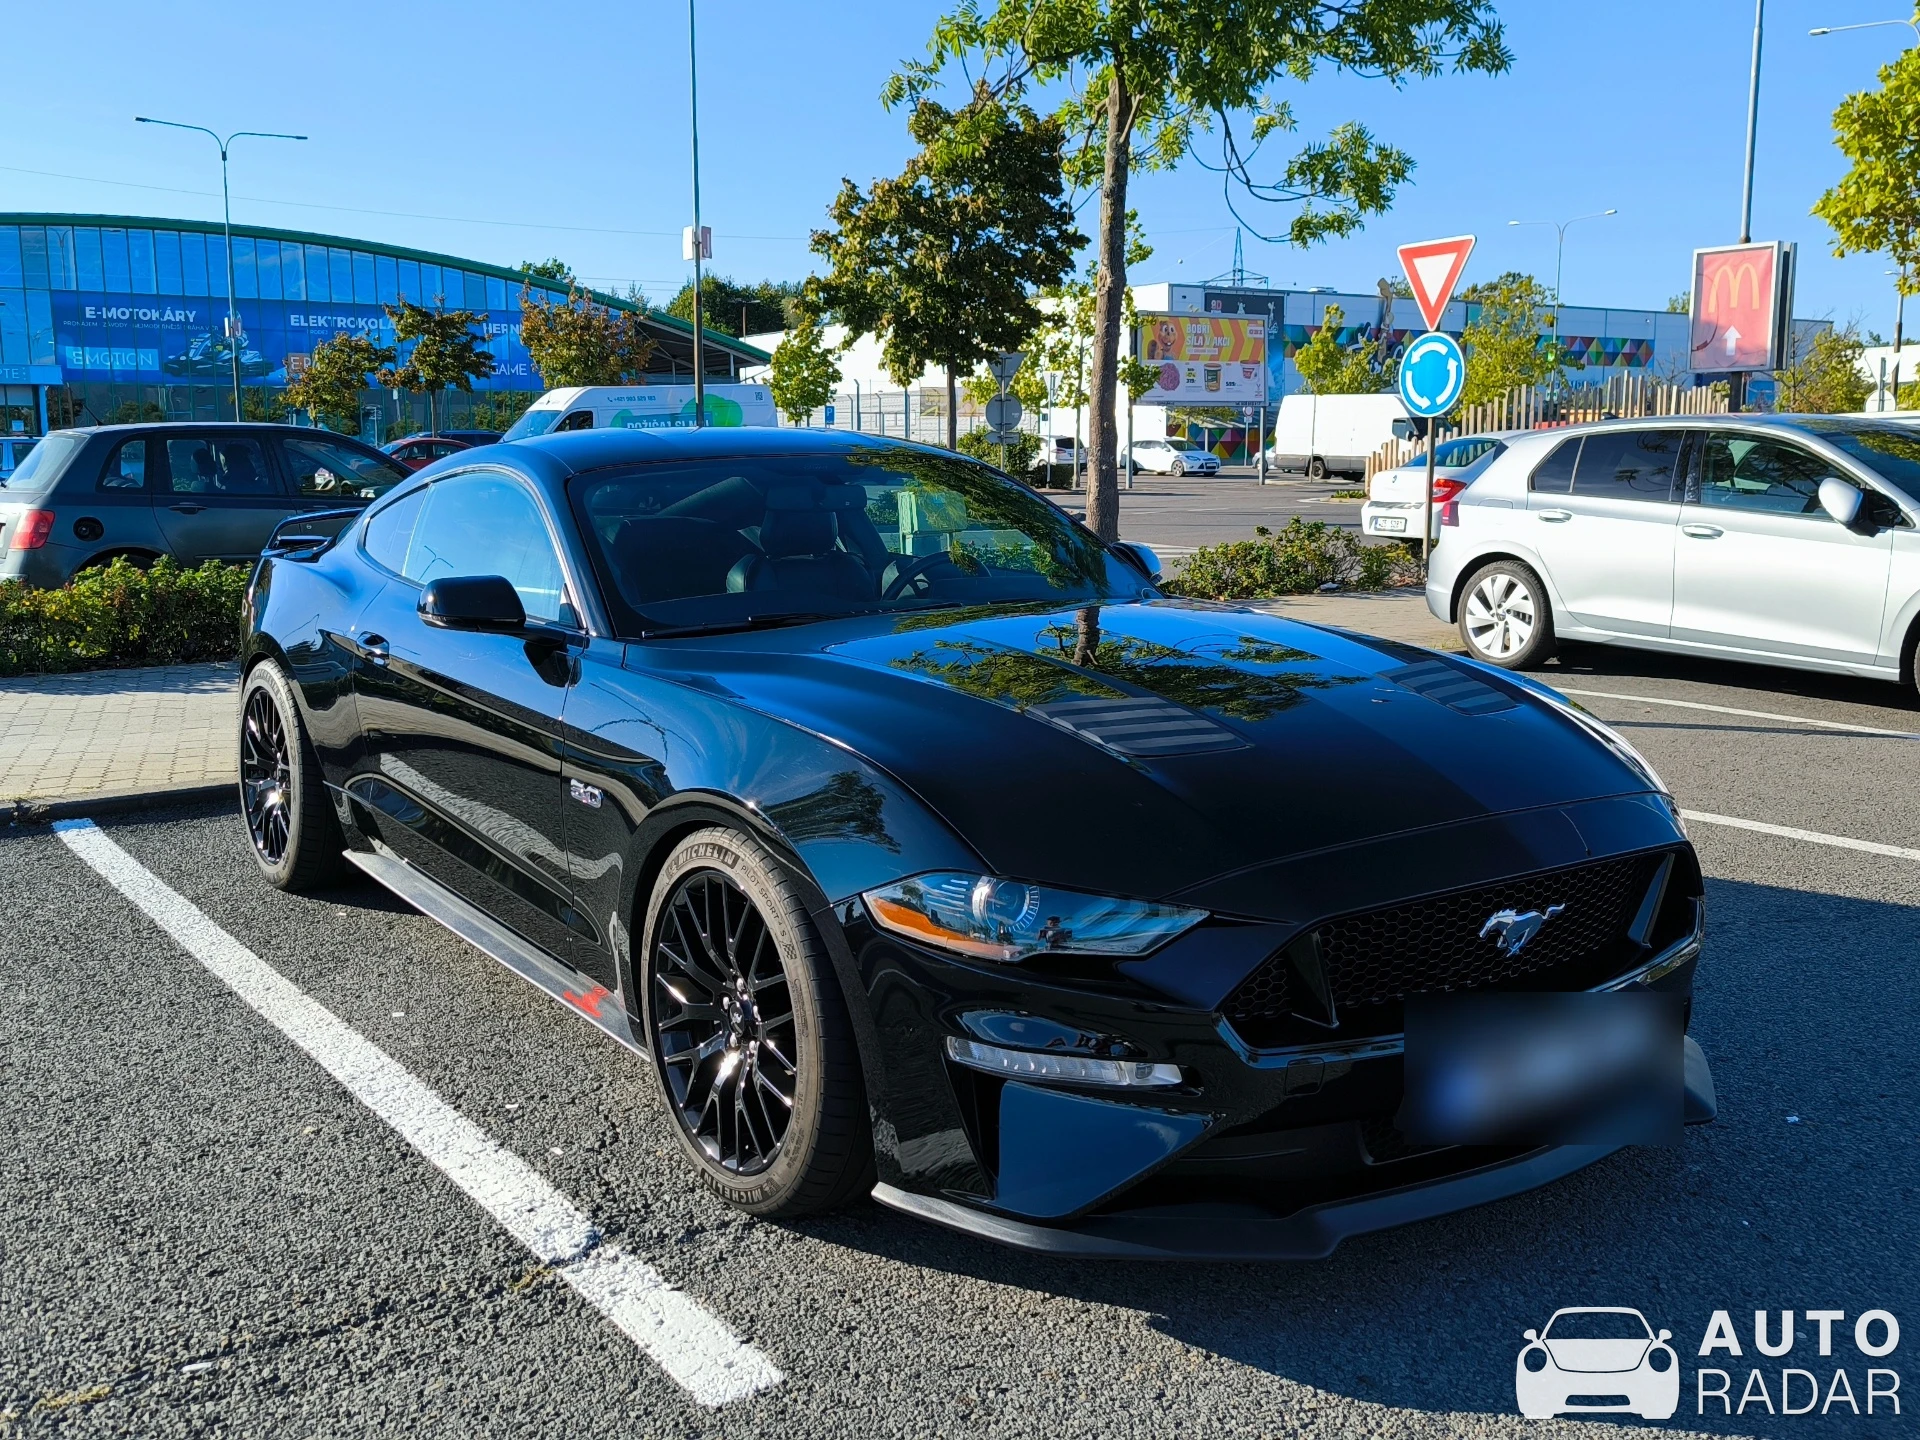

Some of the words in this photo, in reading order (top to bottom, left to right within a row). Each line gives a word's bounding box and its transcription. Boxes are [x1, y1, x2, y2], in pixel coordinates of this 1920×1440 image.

[85, 306, 197, 323] E-MOTOKÁRY
[1213, 336, 1230, 347] AKCI
[72, 351, 153, 366] EMOTION
[490, 362, 528, 376] GAME
[678, 844, 736, 866] MICHELIN
[740, 865, 760, 886] PILOT
[758, 887, 780, 919] SPORT
[703, 1172, 763, 1204] MICHELIN
